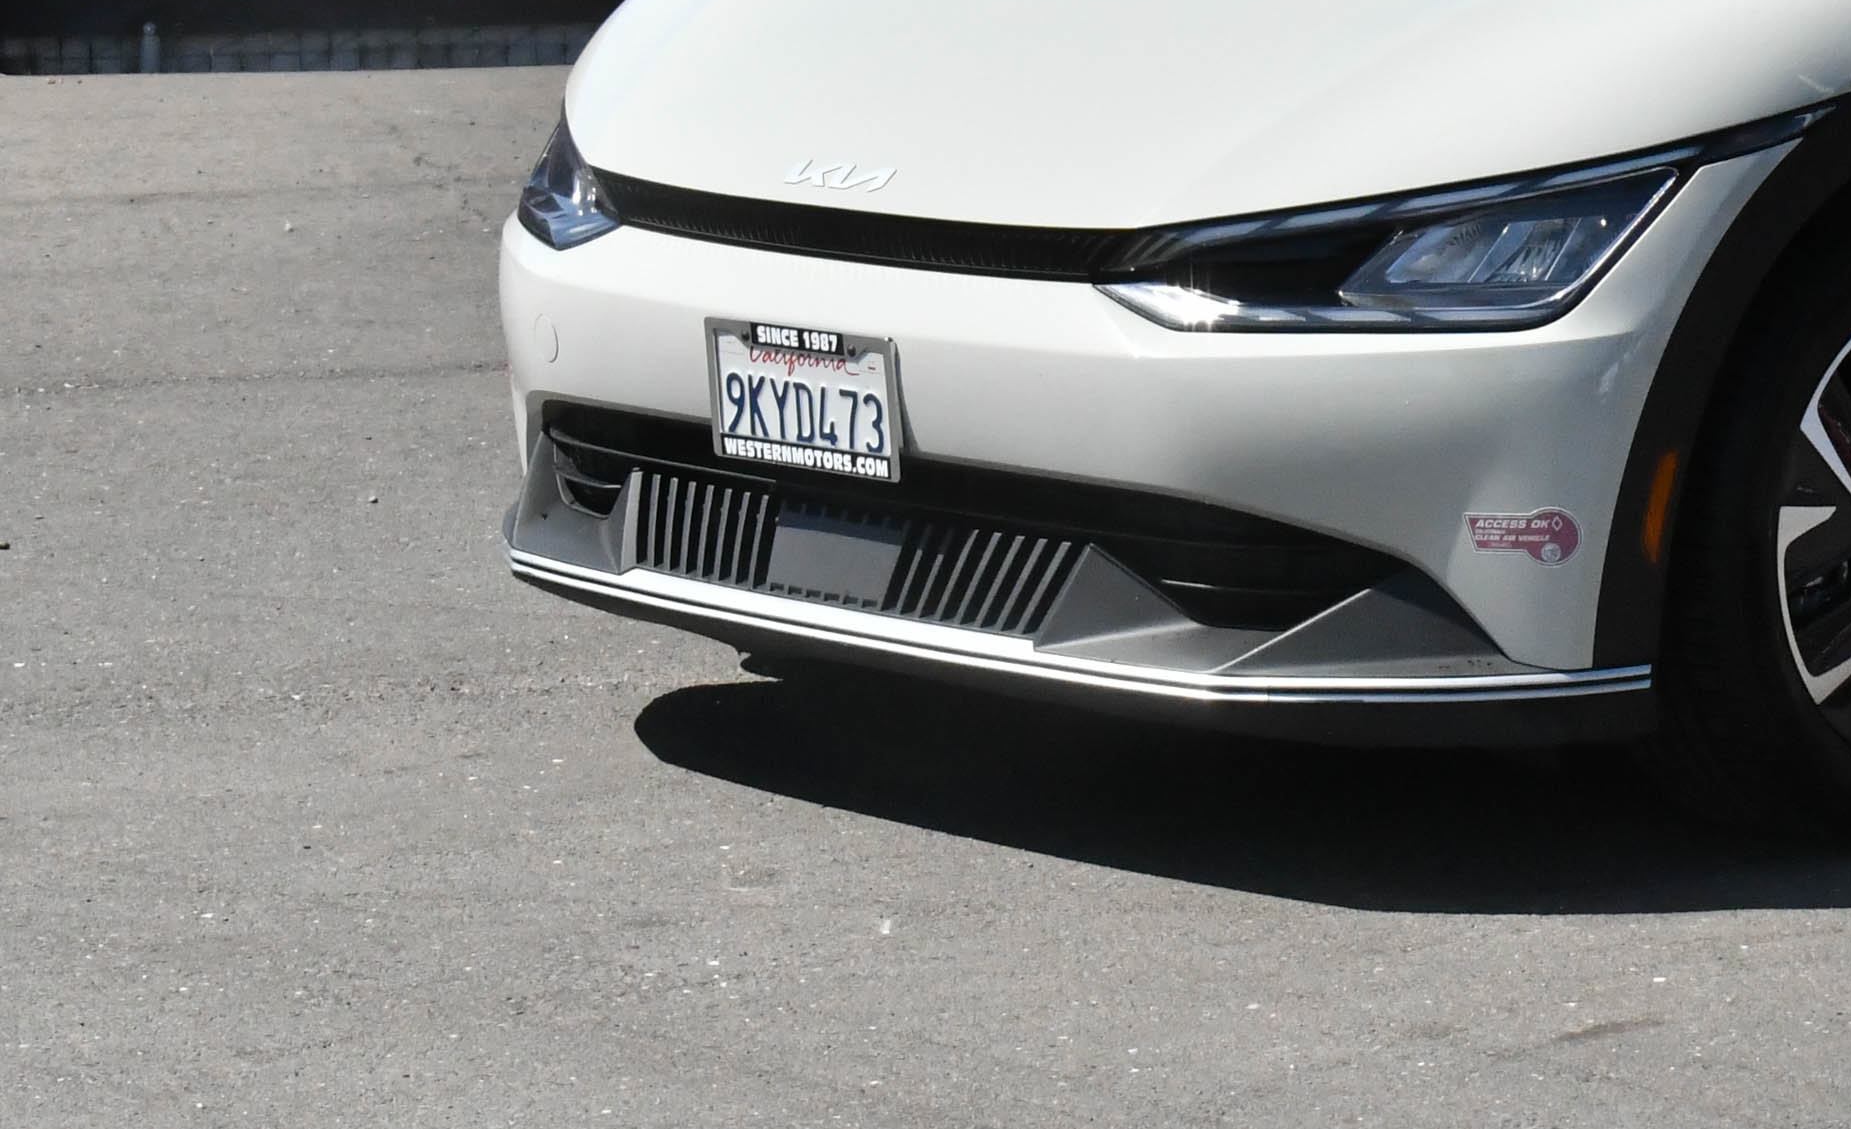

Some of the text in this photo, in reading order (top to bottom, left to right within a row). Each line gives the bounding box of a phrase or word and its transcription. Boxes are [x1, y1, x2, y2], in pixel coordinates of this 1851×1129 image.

[756, 325, 838, 353] SINCE 1987
[726, 372, 884, 454] 9KYD473
[724, 437, 889, 479] WESTERNMOTORS.COM
[1475, 519, 1550, 529] ACCESS OK
